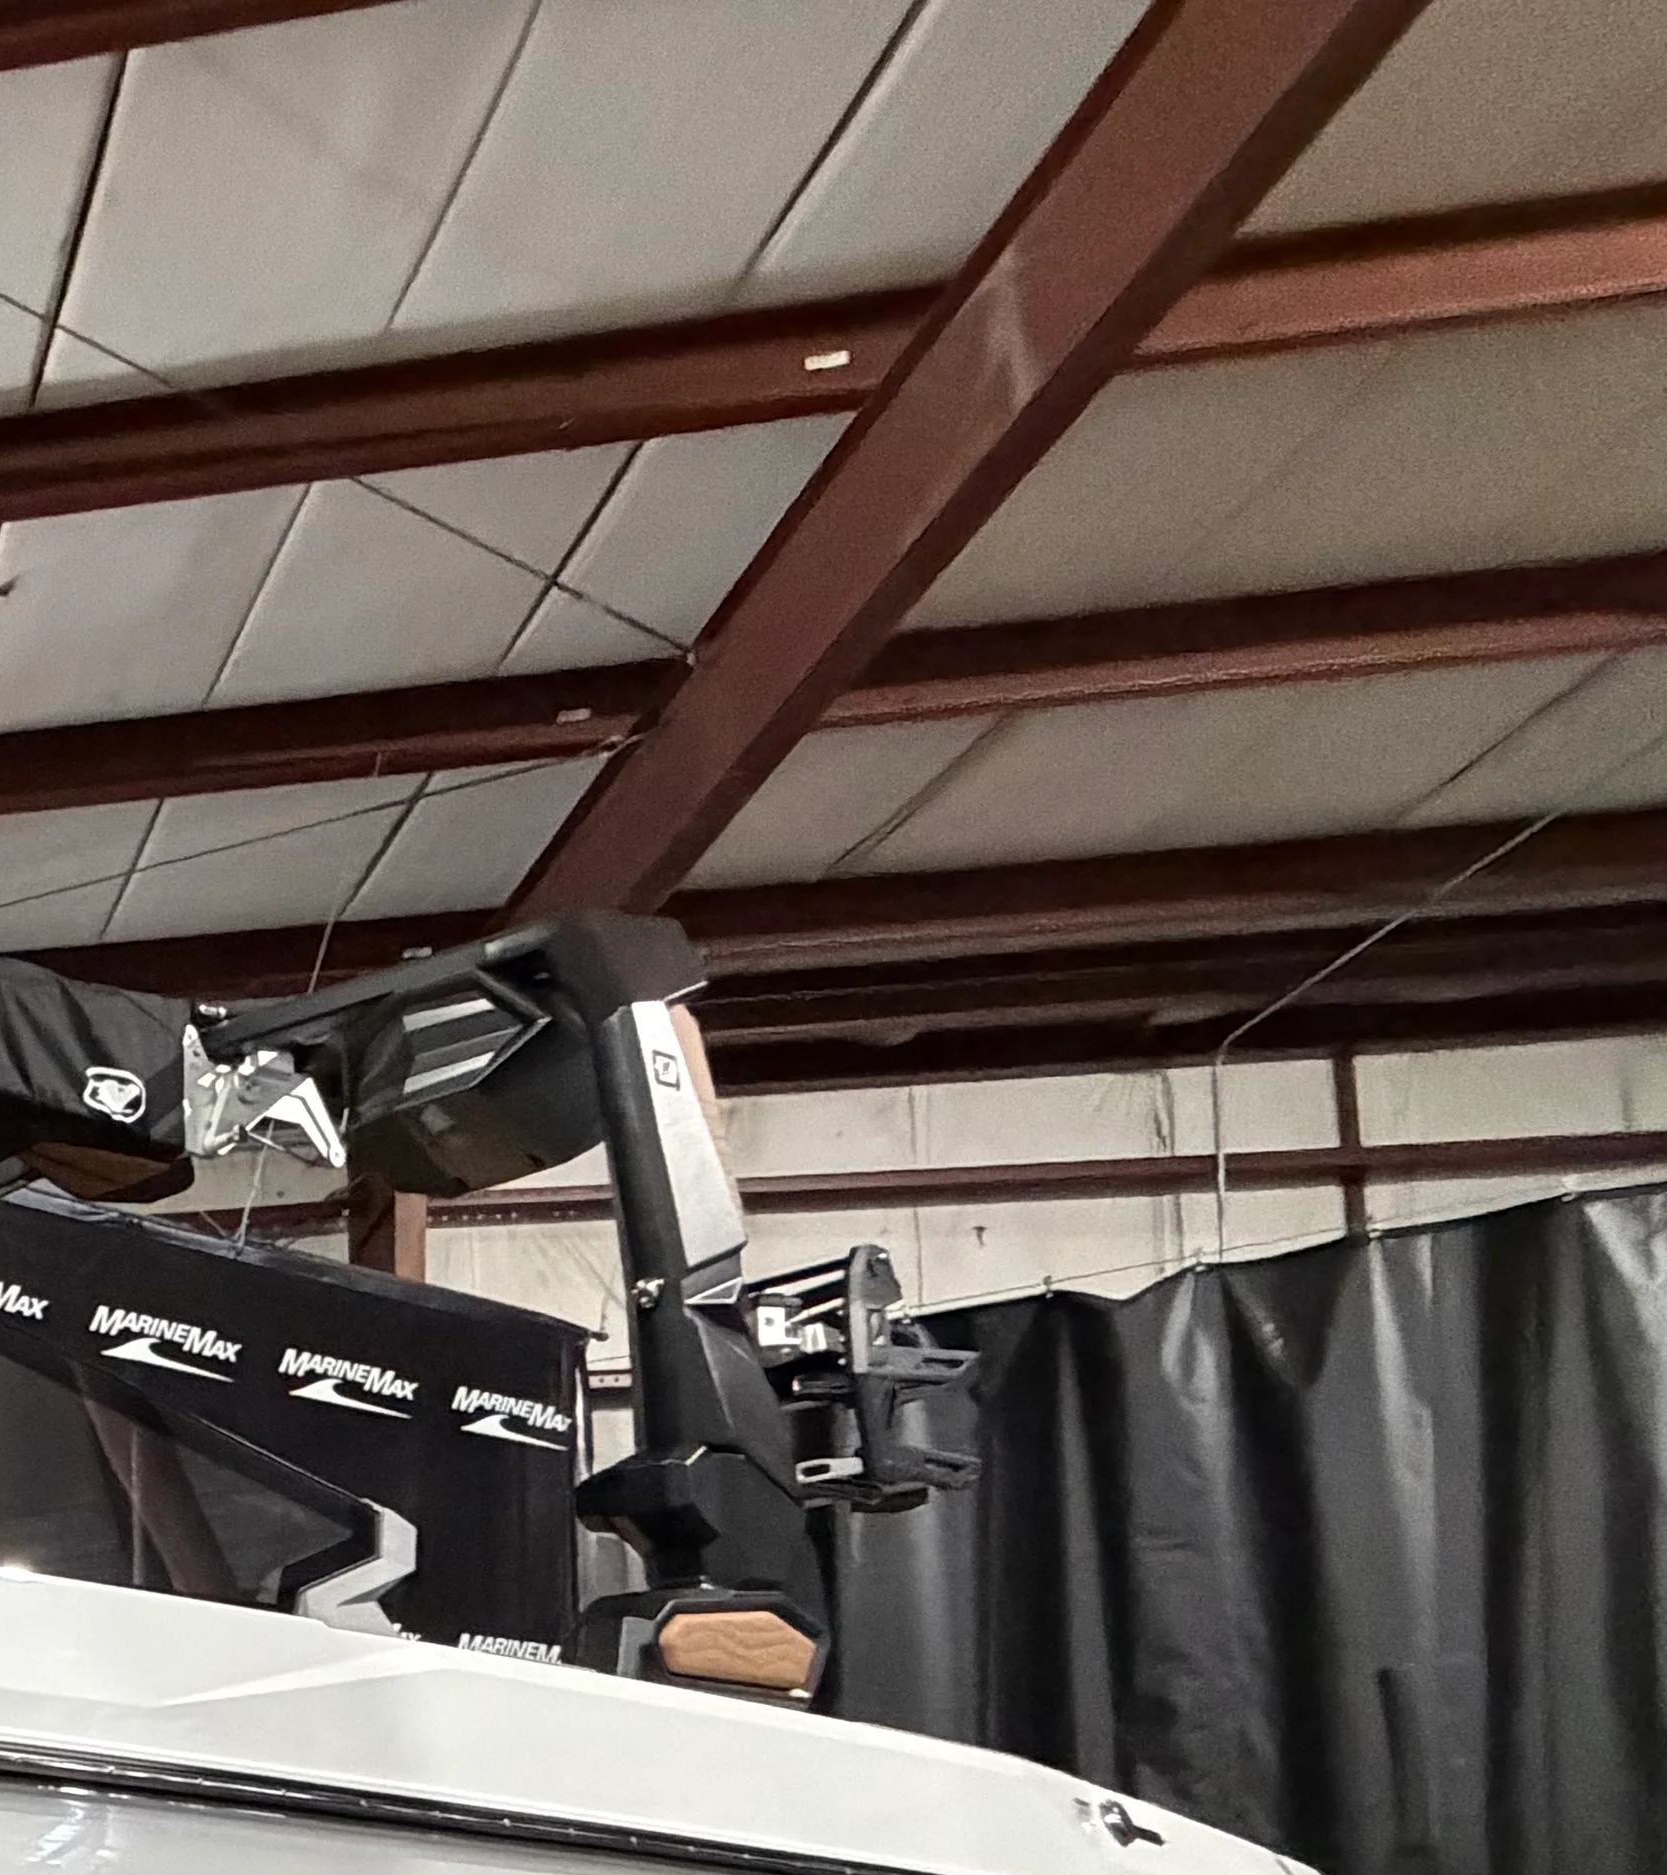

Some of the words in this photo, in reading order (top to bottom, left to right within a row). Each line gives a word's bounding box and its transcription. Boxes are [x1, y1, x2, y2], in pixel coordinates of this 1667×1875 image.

[89, 1305, 242, 1363] MARINEMAX
[278, 1348, 419, 1400] MARINEMAX
[458, 1633, 562, 1664] MARINEM
